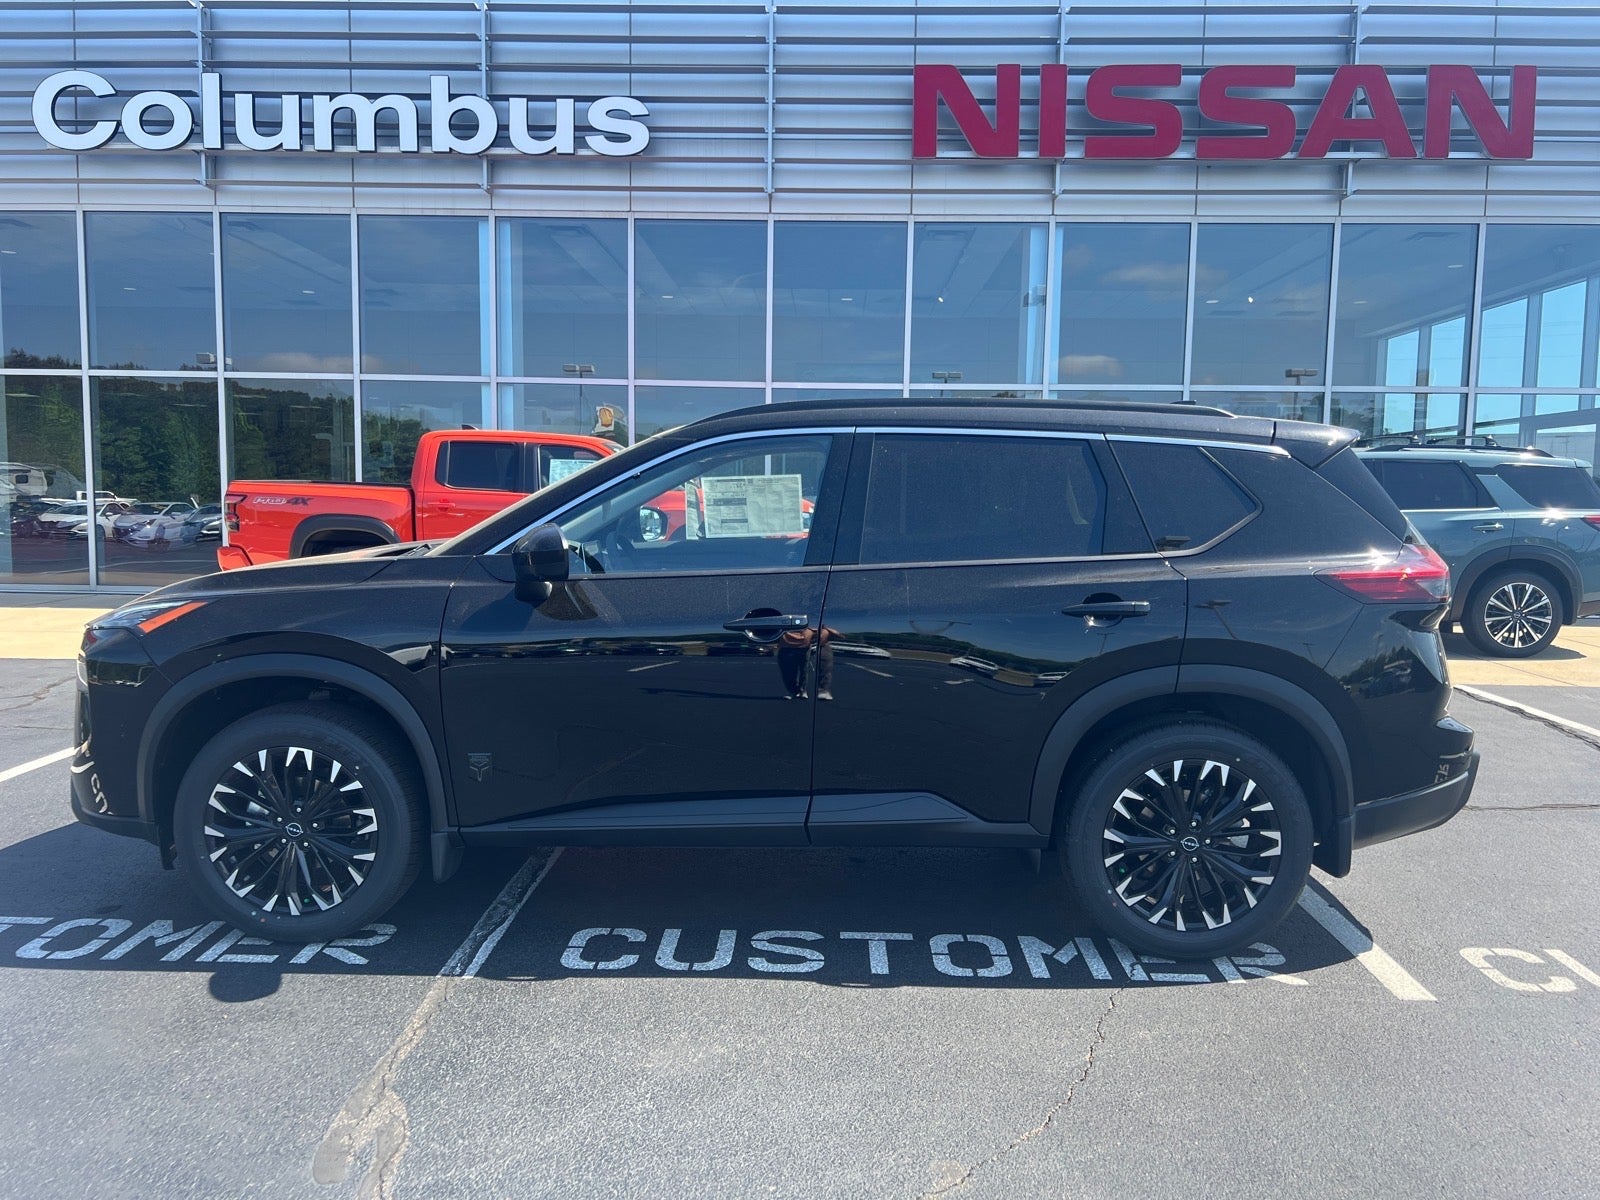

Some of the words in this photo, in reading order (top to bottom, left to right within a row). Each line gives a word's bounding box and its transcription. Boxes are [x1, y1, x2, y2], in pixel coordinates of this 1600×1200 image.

[31, 70, 651, 156] Columbus
[912, 63, 1537, 160] NISSAN
[559, 927, 1310, 985] CUSTOMER
